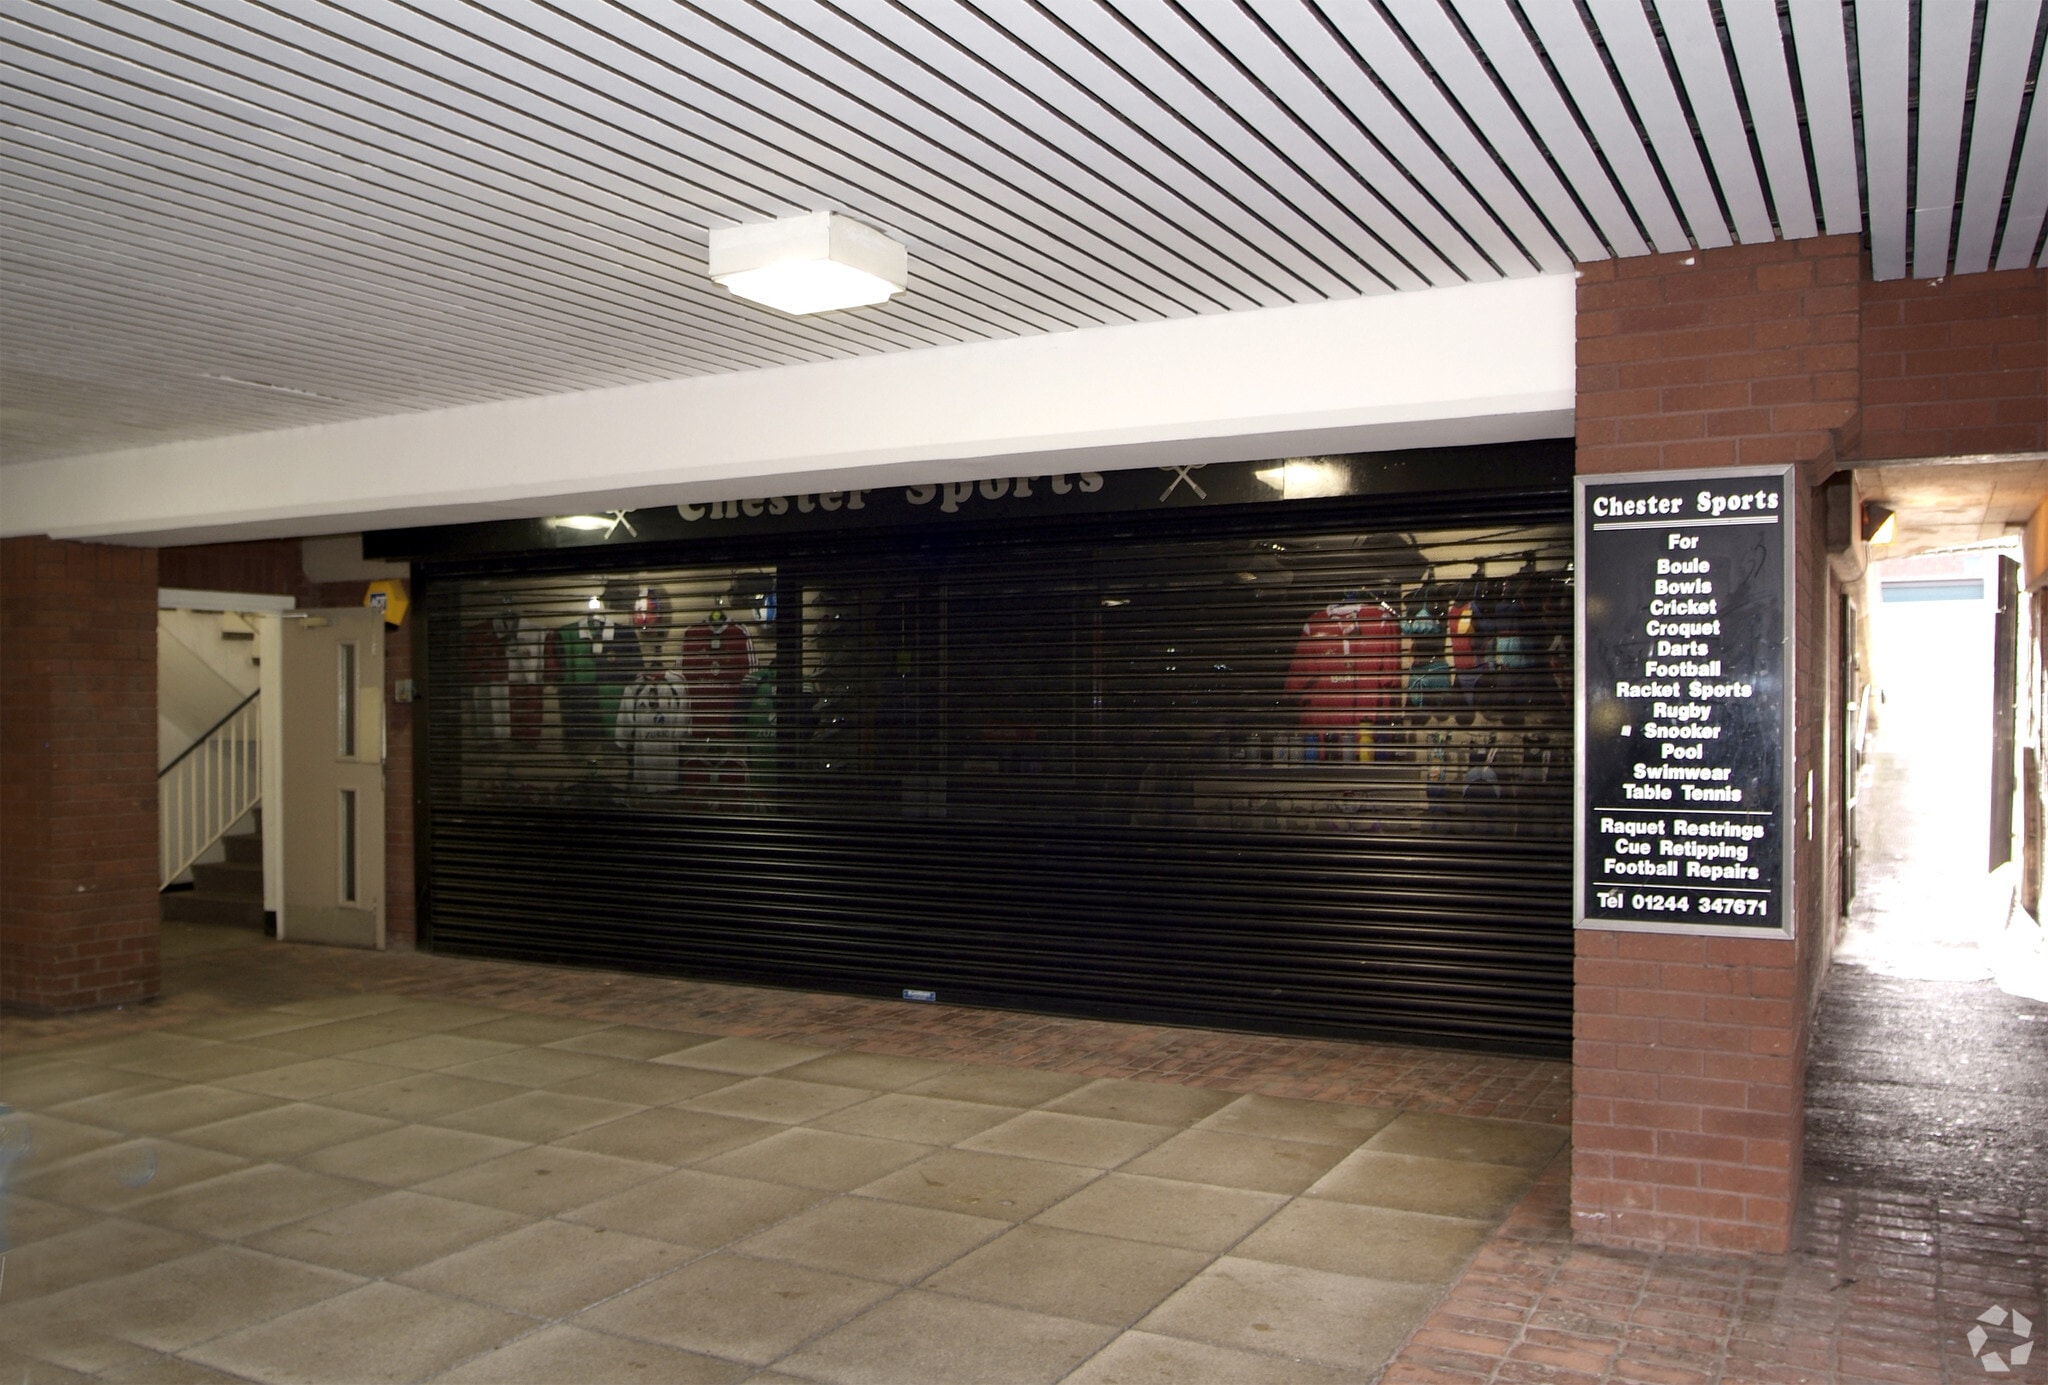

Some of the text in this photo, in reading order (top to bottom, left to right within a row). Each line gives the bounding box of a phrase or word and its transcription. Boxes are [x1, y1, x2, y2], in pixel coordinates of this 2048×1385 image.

[1594, 490, 1778, 516] Chester Sports
[1669, 534, 1698, 549] For
[1658, 558, 1710, 574] Boule
[1655, 578, 1712, 594] Bowls
[1650, 599, 1717, 615] Cricket
[1647, 620, 1720, 638] Croquet
[1658, 641, 1708, 656] Darts
[1646, 661, 1720, 677] Football
[1617, 681, 1752, 699] Racket Sports
[1654, 702, 1711, 721] Rugby
[1645, 723, 1721, 739] Snooker
[1662, 743, 1702, 759] Pool
[1634, 763, 1731, 780] Swimwear
[1623, 784, 1741, 801] Table Tennis
[1601, 818, 1764, 840] Raquet Restrings
[1616, 838, 1748, 861] Cue Retipping
[1605, 859, 1759, 881] Football Repairs
[1597, 892, 1766, 915] Tel 01244 347671
